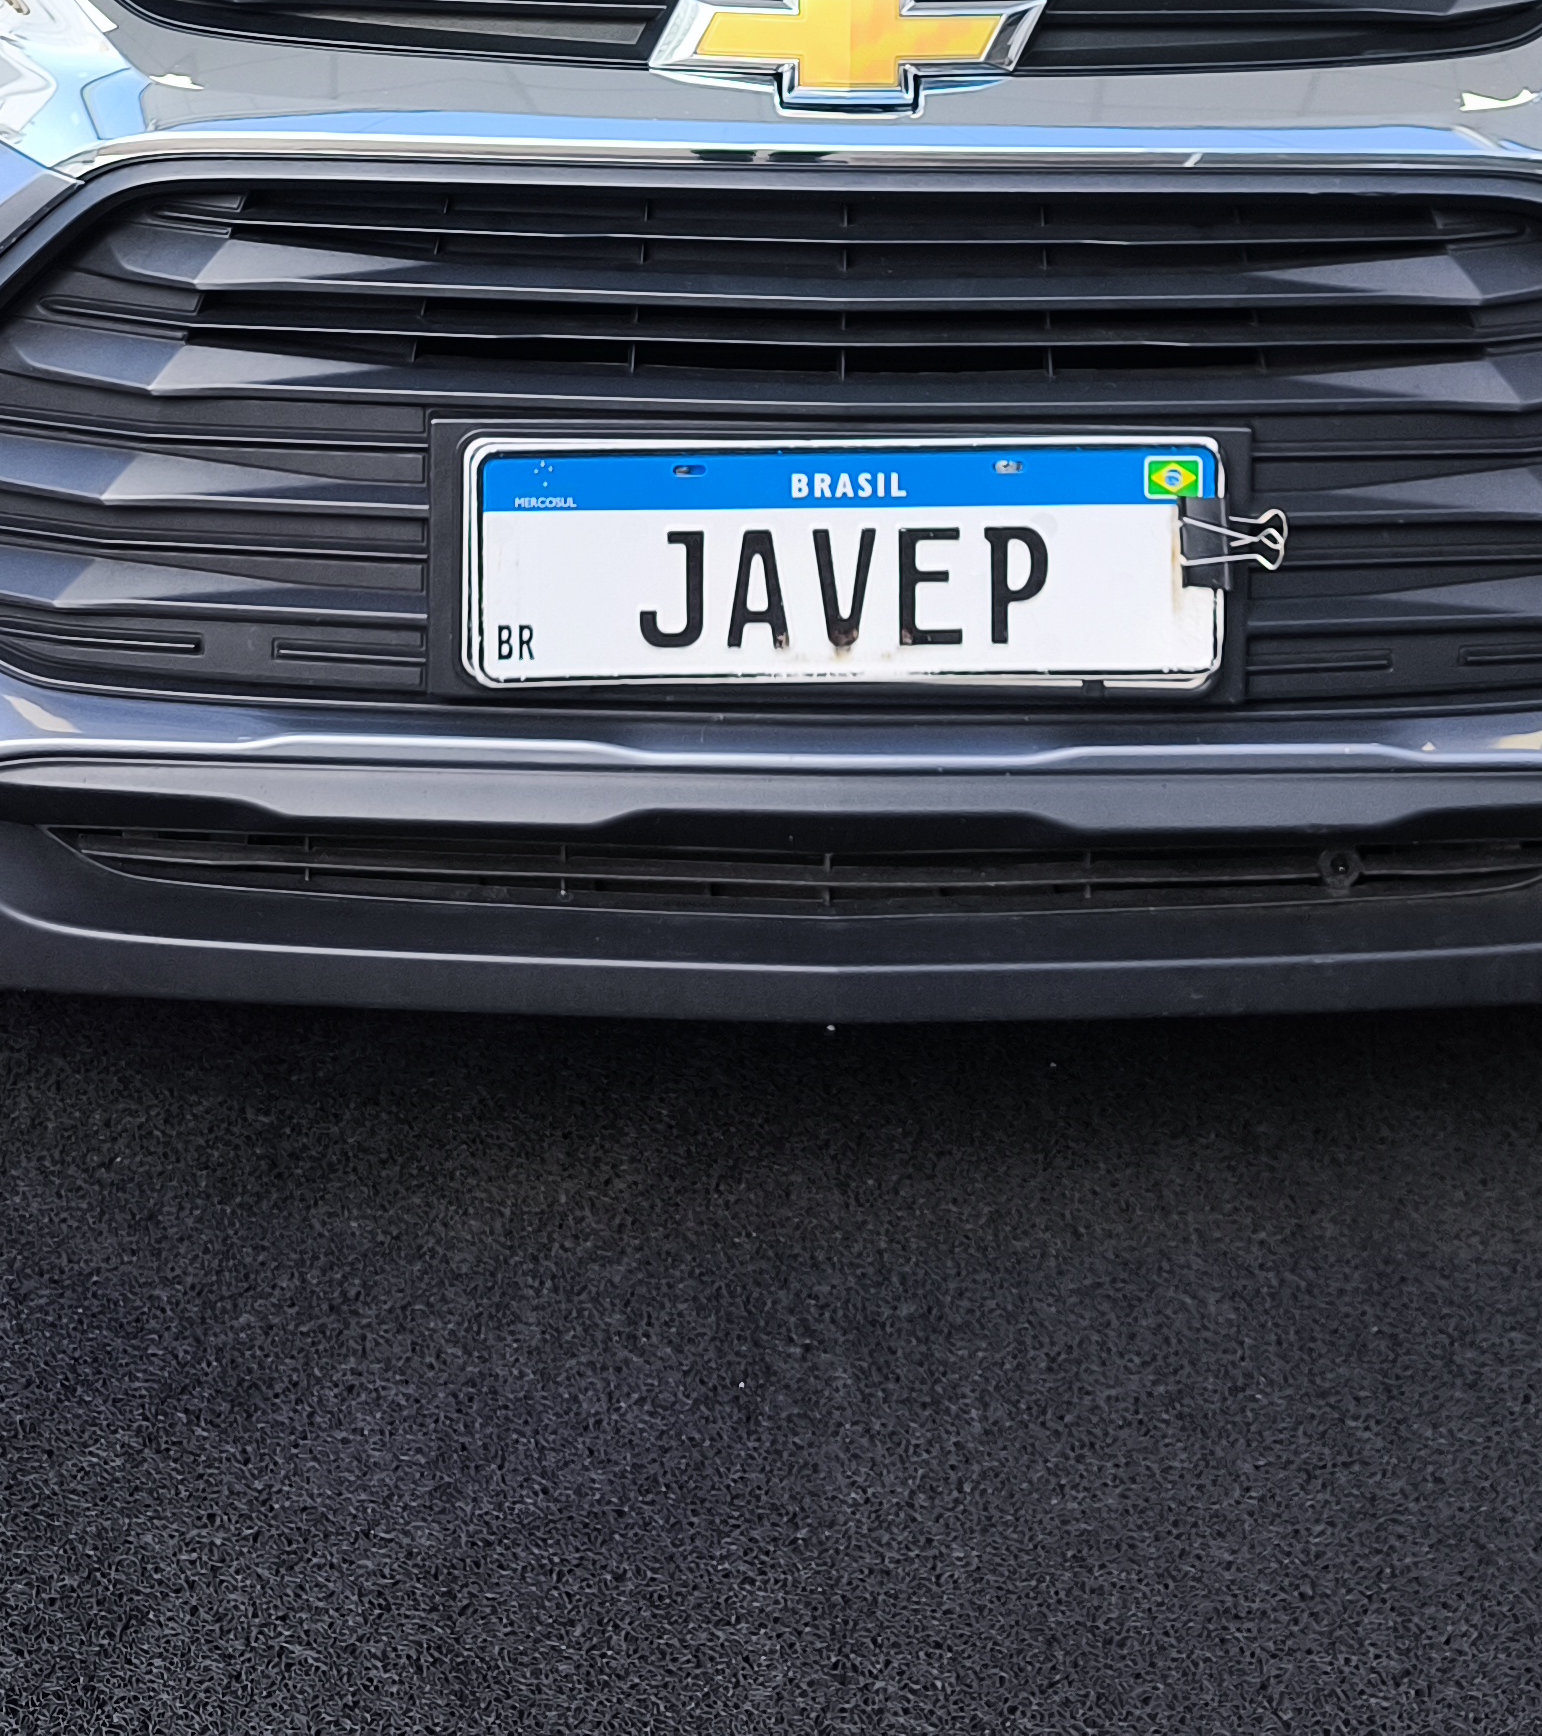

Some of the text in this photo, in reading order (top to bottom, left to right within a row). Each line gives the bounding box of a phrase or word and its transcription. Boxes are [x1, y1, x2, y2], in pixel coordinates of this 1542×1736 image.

[790, 472, 908, 500] BRASIL
[514, 496, 578, 509] MERCOSUL
[638, 525, 1050, 650] JAVEP
[497, 624, 535, 661] BR
